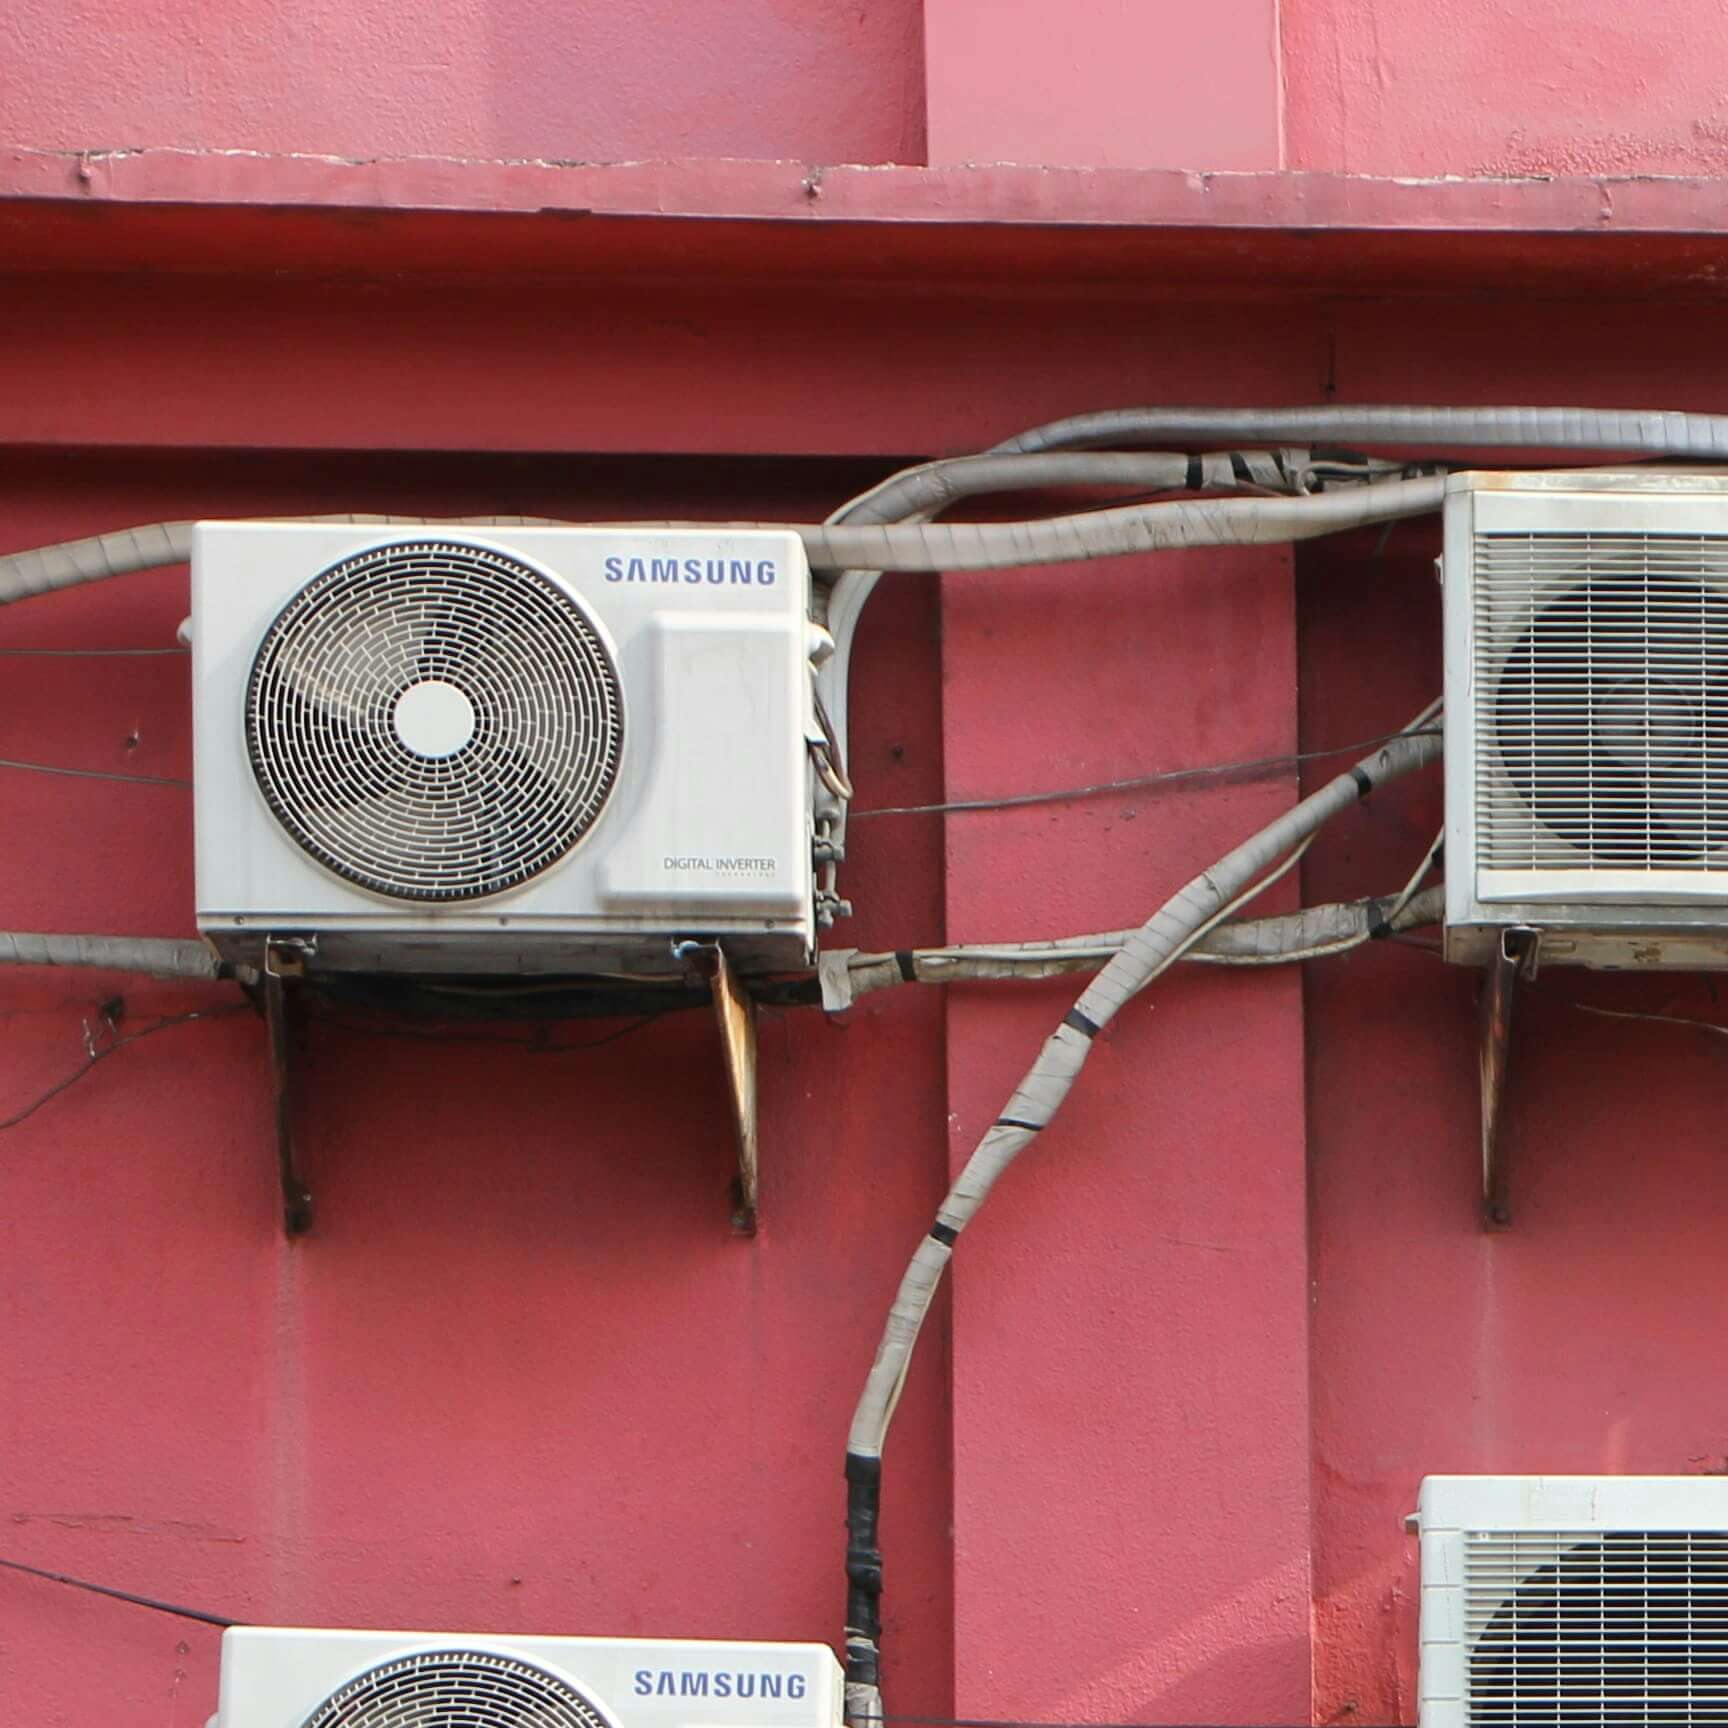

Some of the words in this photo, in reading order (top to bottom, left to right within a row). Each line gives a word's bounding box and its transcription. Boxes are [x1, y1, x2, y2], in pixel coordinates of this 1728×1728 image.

[604, 556, 776, 586] SAMSUNG
[663, 856, 713, 871] DIGITAL
[716, 857, 776, 871] INVERTER
[634, 1669, 806, 1700] SAMSUNG
